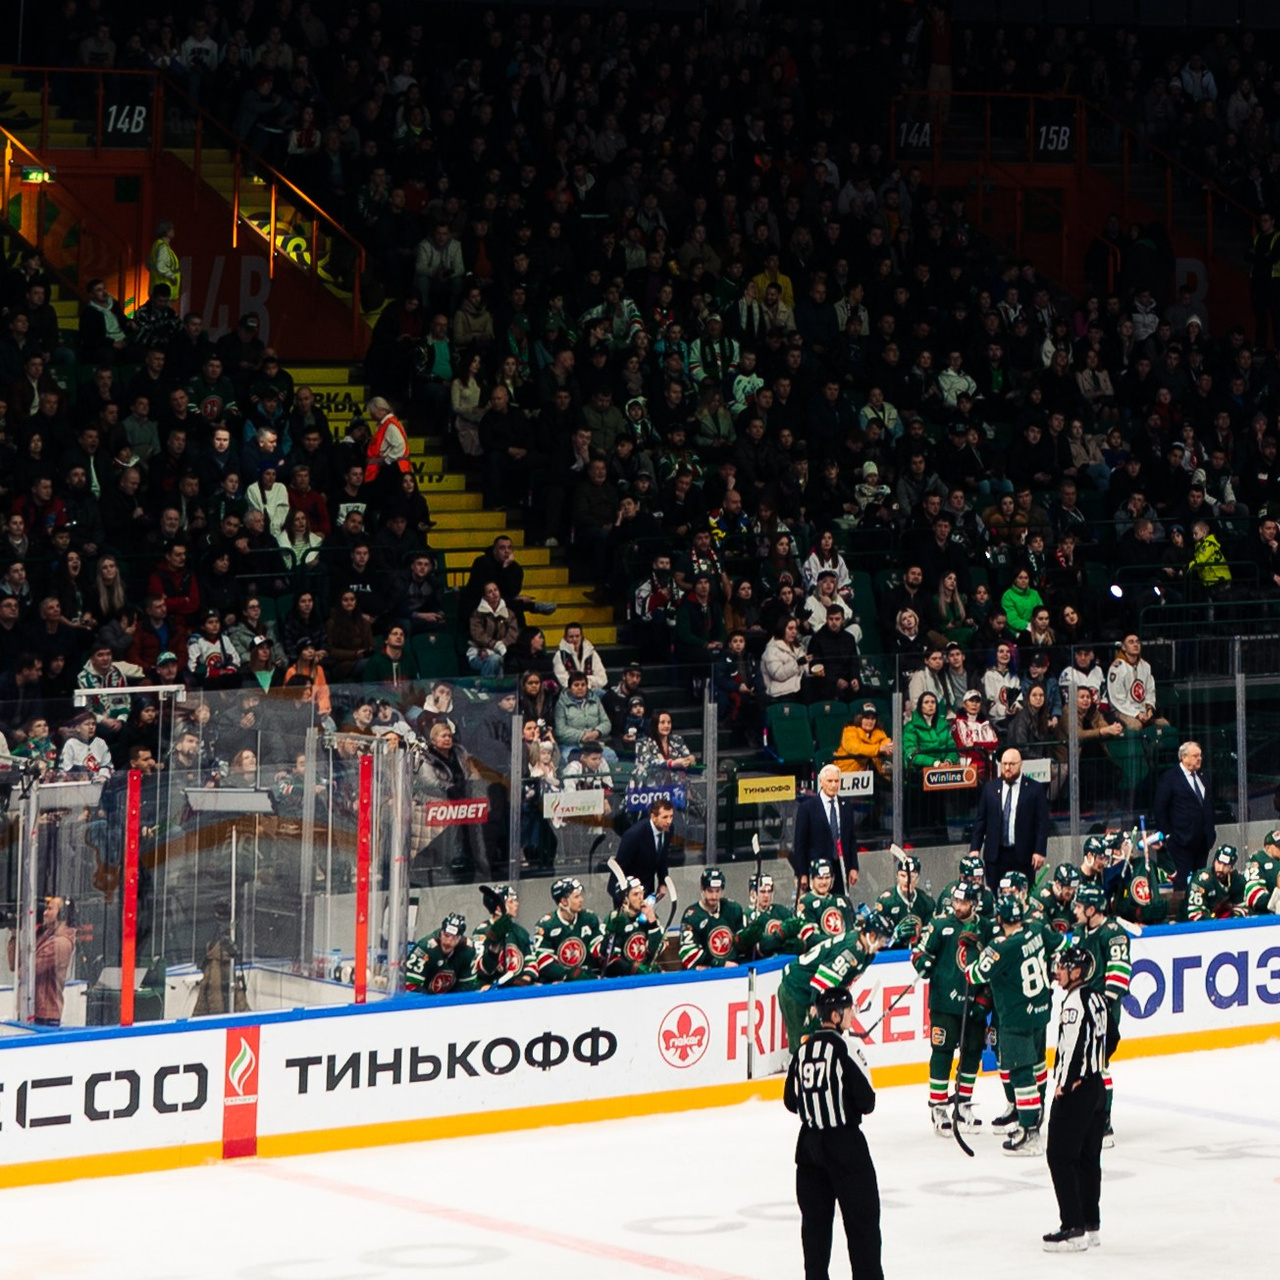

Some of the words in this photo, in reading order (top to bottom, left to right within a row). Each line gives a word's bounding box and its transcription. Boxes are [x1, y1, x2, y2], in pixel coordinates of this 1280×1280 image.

[105, 103, 147, 135] 14B
[897, 121, 932, 149] 14A
[1037, 124, 1072, 152] 15B
[840, 776, 870, 793] L.RU
[929, 772, 962, 784] Winline
[743, 783, 791, 796] ТИНЬКОФФ
[427, 802, 487, 822] FONBET
[560, 802, 597, 815] TATNEFT
[1187, 890, 1202, 905] 26
[1110, 944, 1128, 961] 92
[406, 954, 425, 973] 23
[831, 956, 851, 977] 96
[725, 982, 931, 1062] RIKE
[668, 1034, 702, 1048] rieker
[284, 1026, 618, 1096] ТИНЬКОФФ
[802, 1060, 827, 1090] 97
